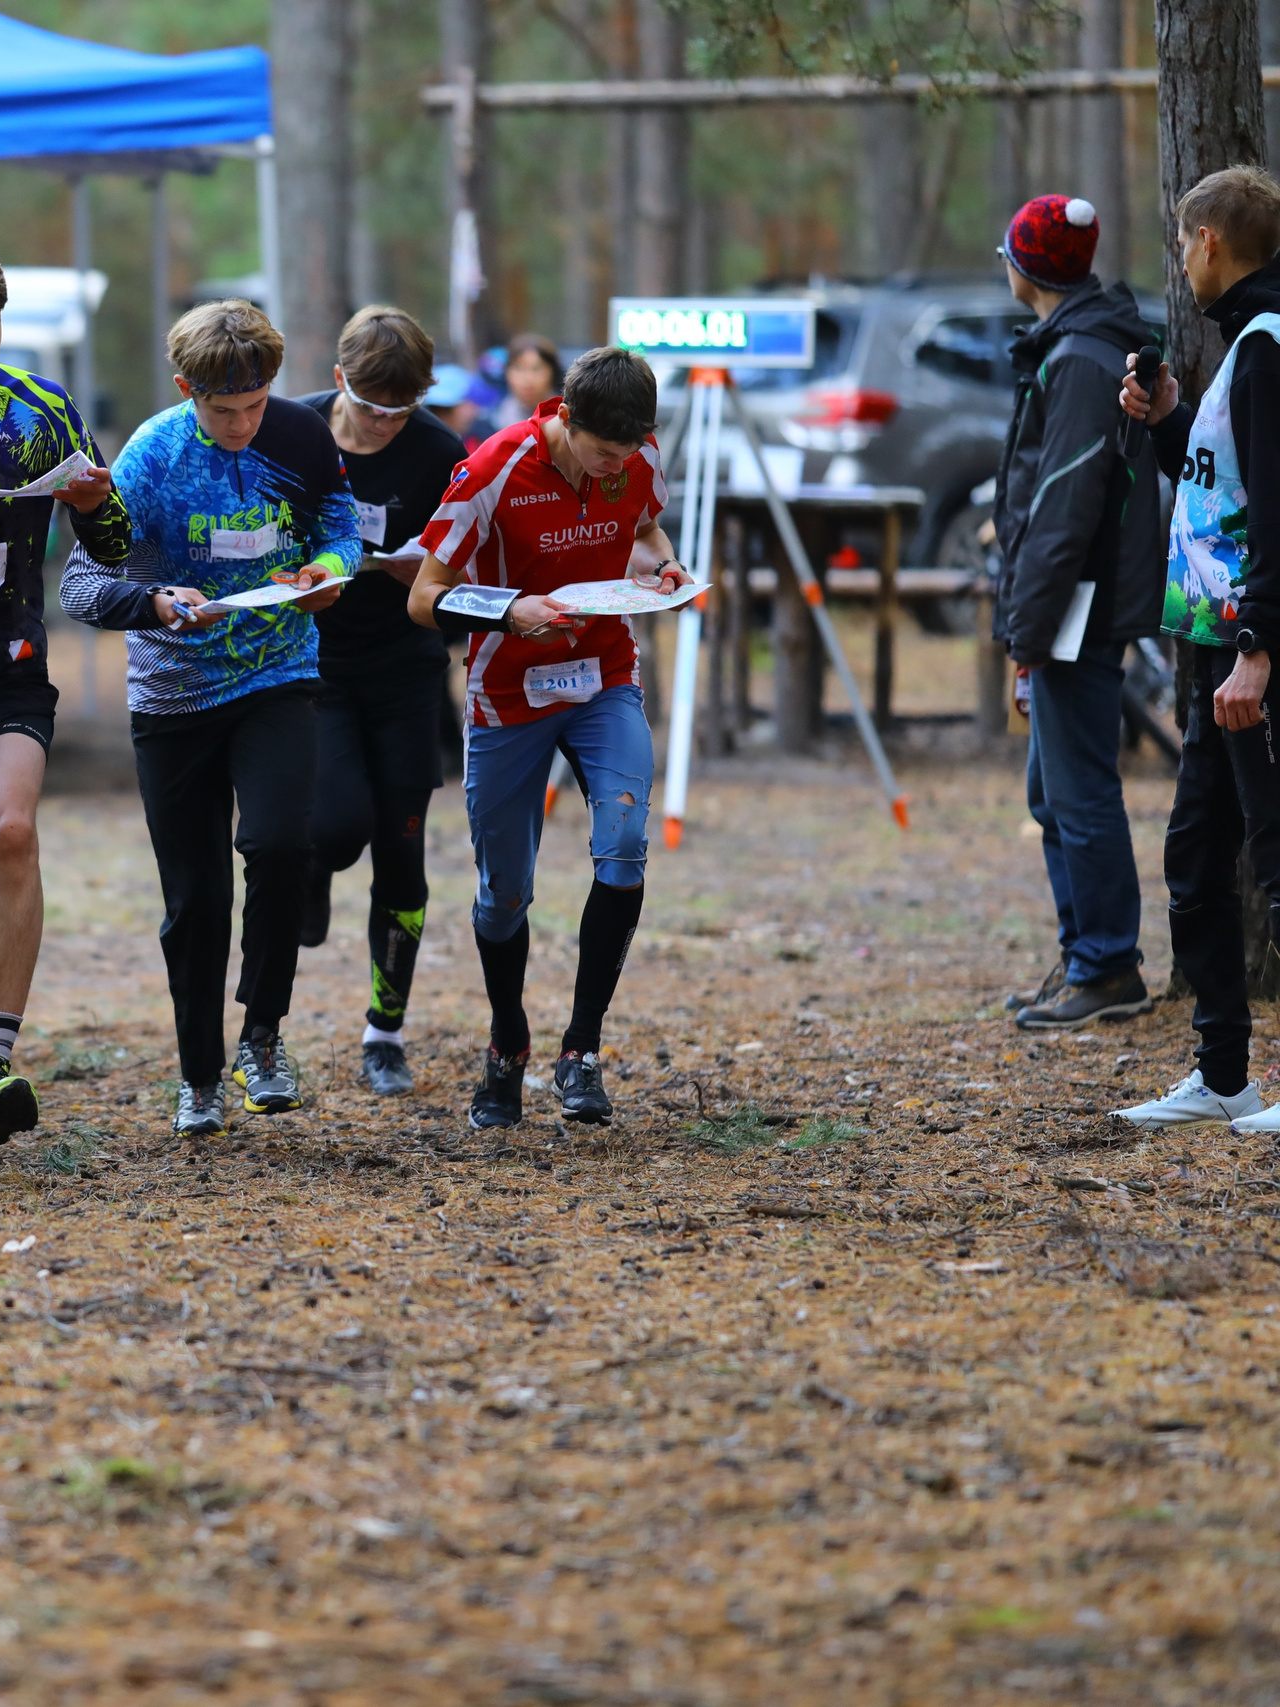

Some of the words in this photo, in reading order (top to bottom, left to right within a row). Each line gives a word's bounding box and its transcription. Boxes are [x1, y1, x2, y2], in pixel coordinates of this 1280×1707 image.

[510, 491, 561, 508] RUSSIA
[539, 520, 619, 549] SUUNTO
[545, 677, 578, 691] 201
